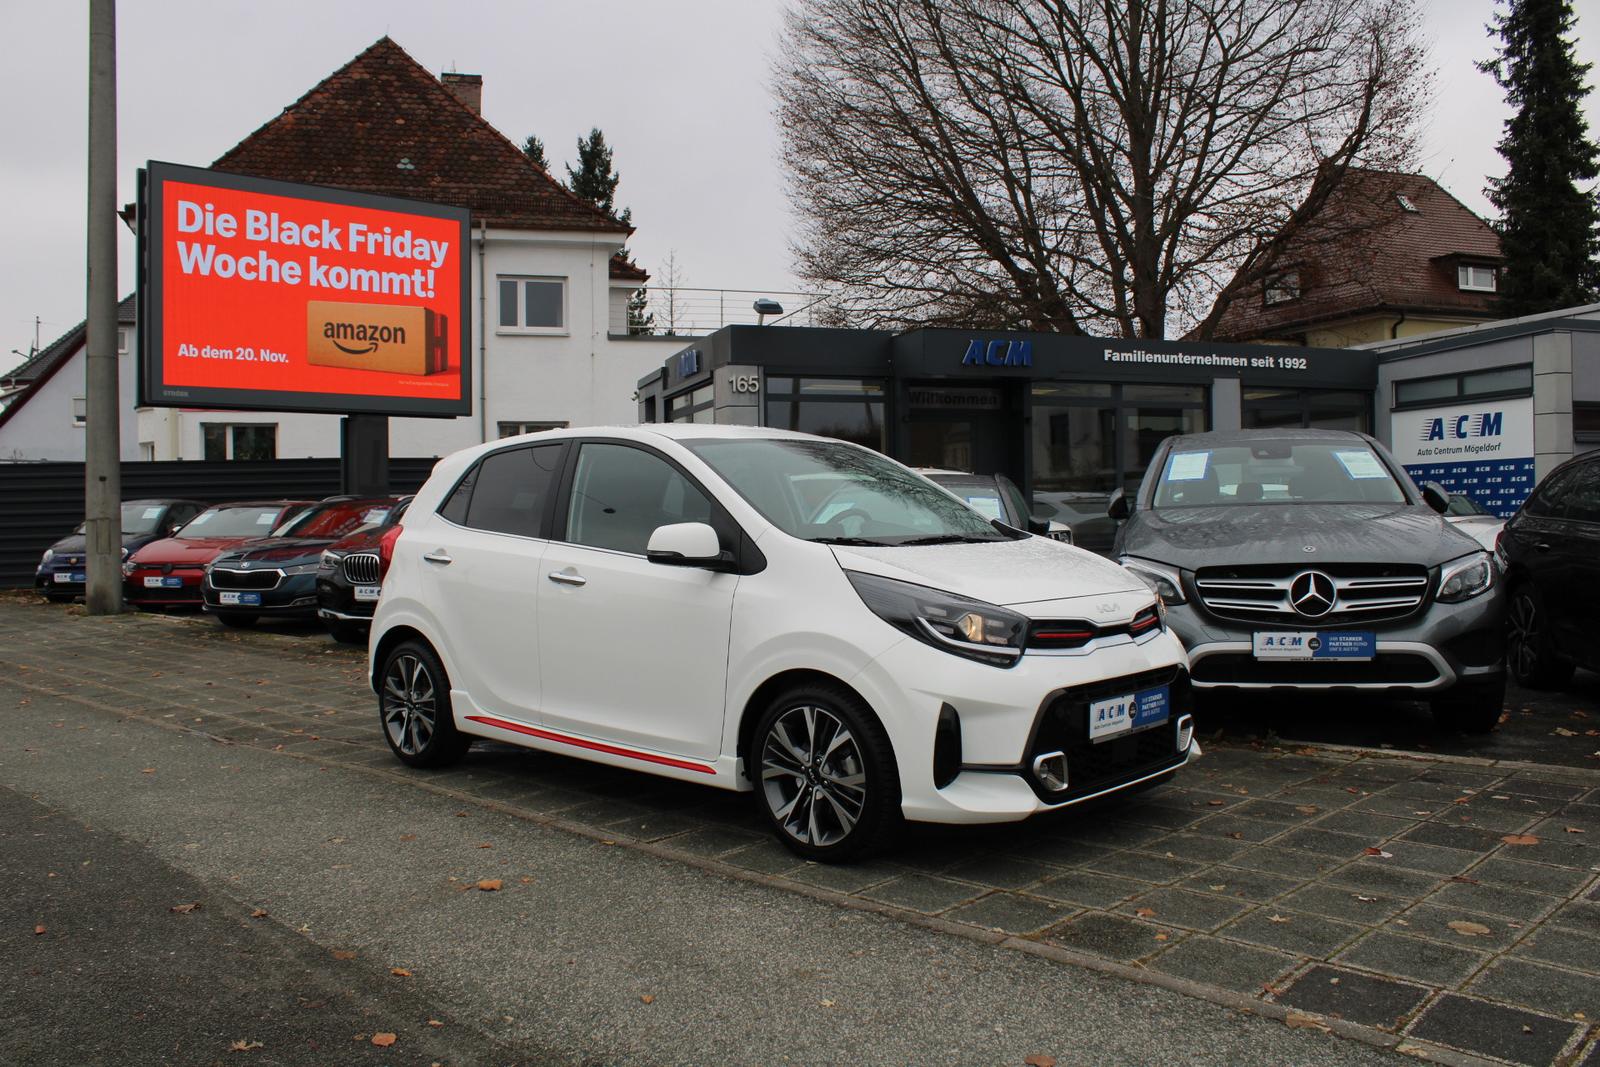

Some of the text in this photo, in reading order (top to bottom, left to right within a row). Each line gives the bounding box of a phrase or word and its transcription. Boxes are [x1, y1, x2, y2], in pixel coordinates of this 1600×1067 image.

[177, 200, 449, 268] Die Black Friday
[176, 240, 435, 298] Woche kommt!
[323, 322, 406, 345] amazon
[177, 344, 289, 364] Ab dem 20. Nov.
[962, 339, 1032, 367] ACM
[1104, 350, 1307, 370] Familienunternehmen seit 1992
[728, 375, 760, 393] 165
[908, 391, 998, 406] Willkommen
[1422, 411, 1503, 441] ACM
[1434, 447, 1463, 456] Centrum
[1464, 443, 1502, 454] Mögeldorf
[1264, 637, 1303, 646] ACM
[1097, 704, 1125, 721] ACM
